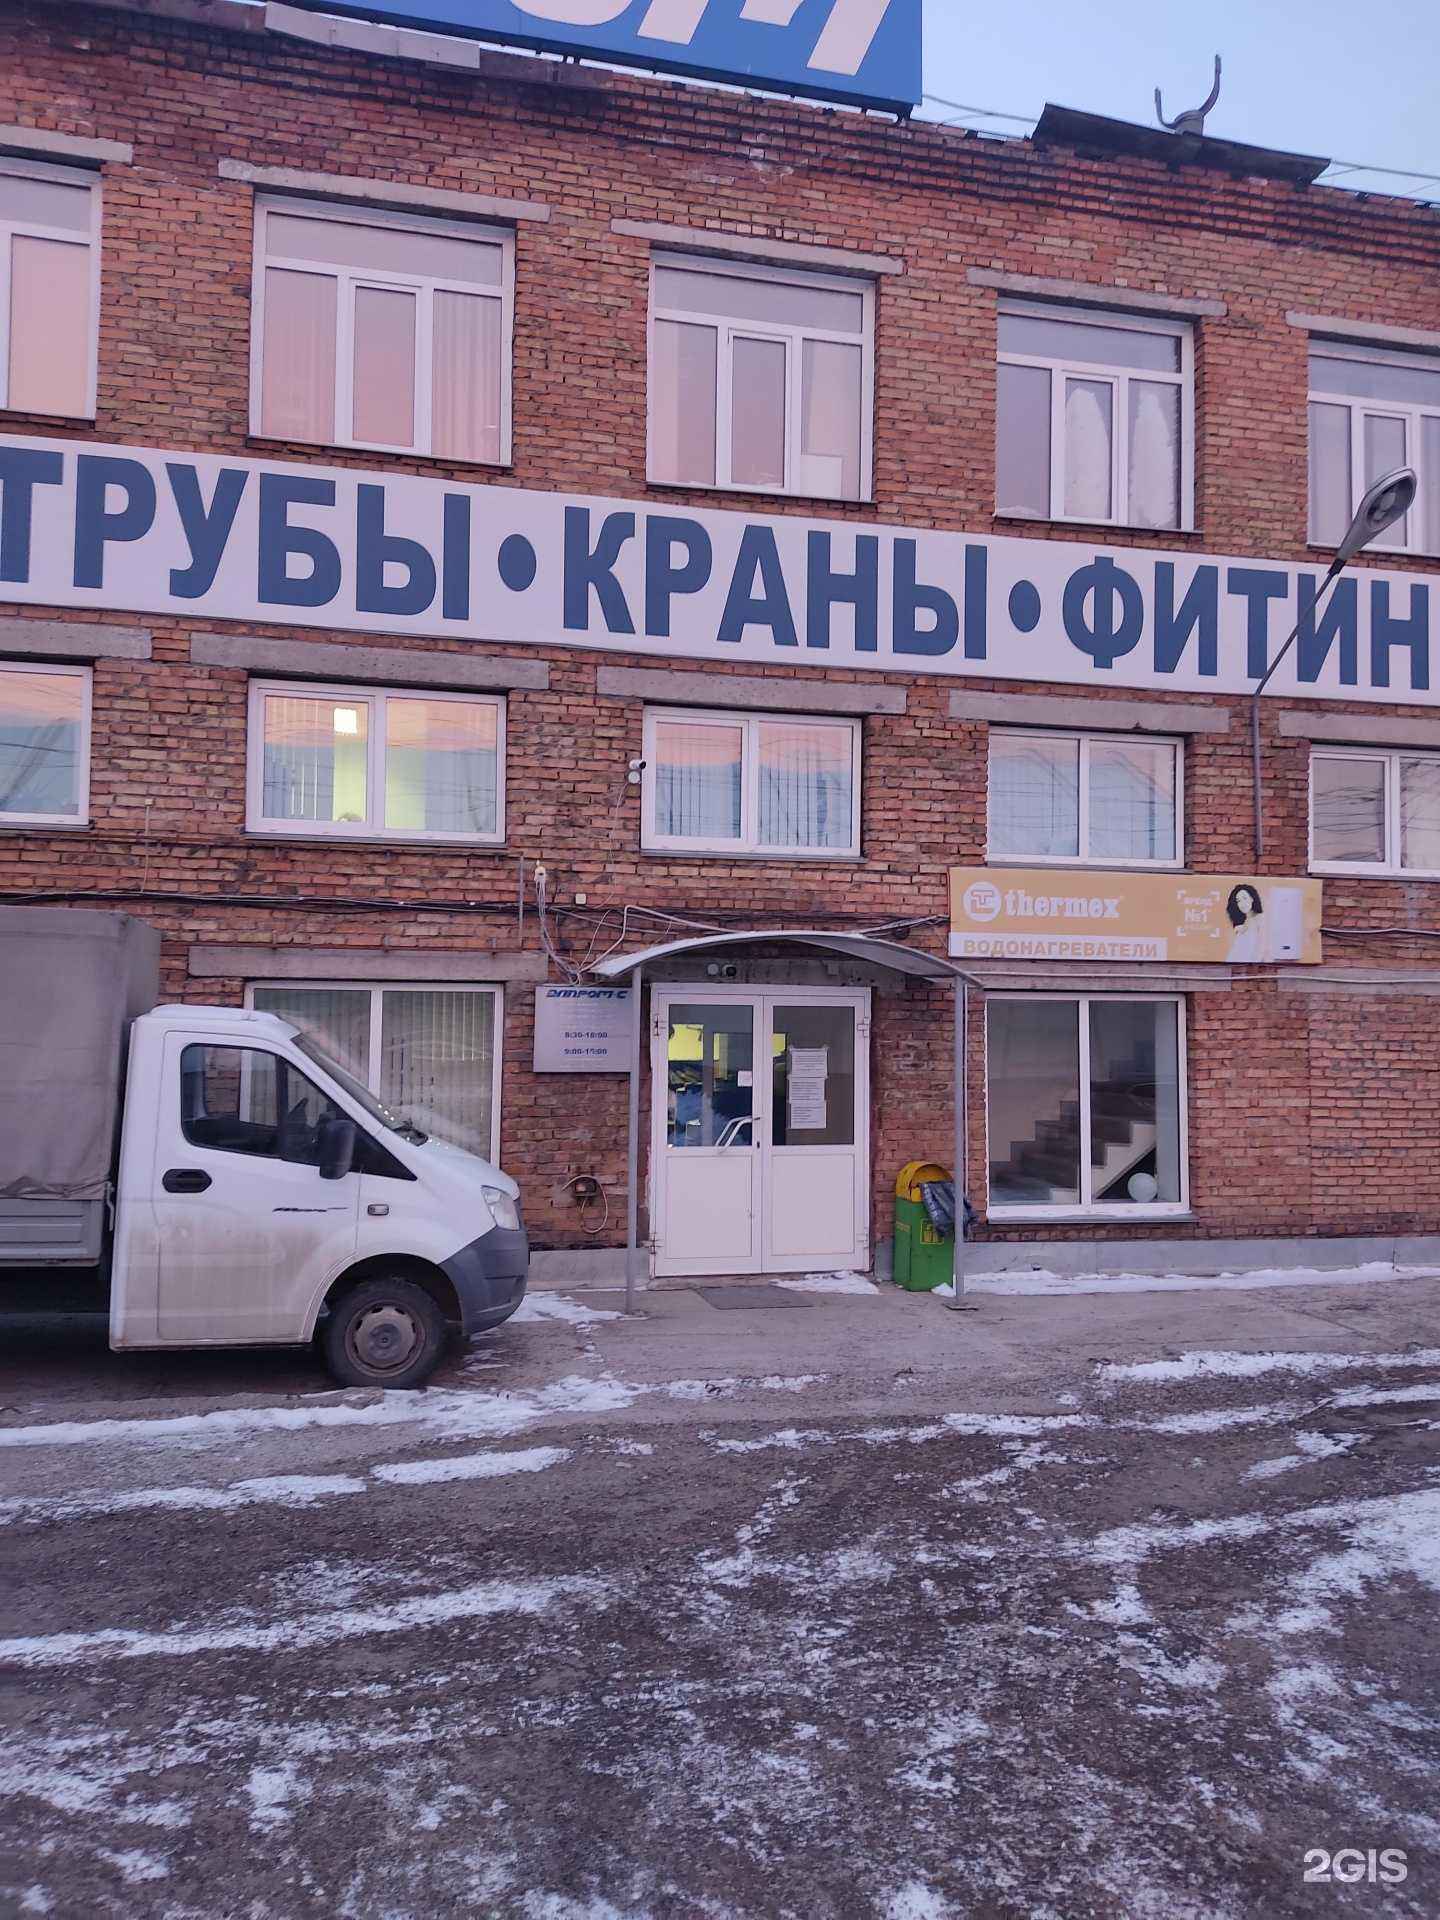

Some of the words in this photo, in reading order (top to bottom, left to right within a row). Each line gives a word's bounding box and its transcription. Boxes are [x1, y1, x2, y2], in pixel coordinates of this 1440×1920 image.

[0, 446, 471, 621] ТРУБЫ
[563, 505, 988, 661] КРАНЫ
[1062, 556, 1430, 691] ФИТИН
[1004, 889, 1121, 919] thermex
[963, 939, 1158, 958] ВОДОНАГРЕВАТЕЛИ
